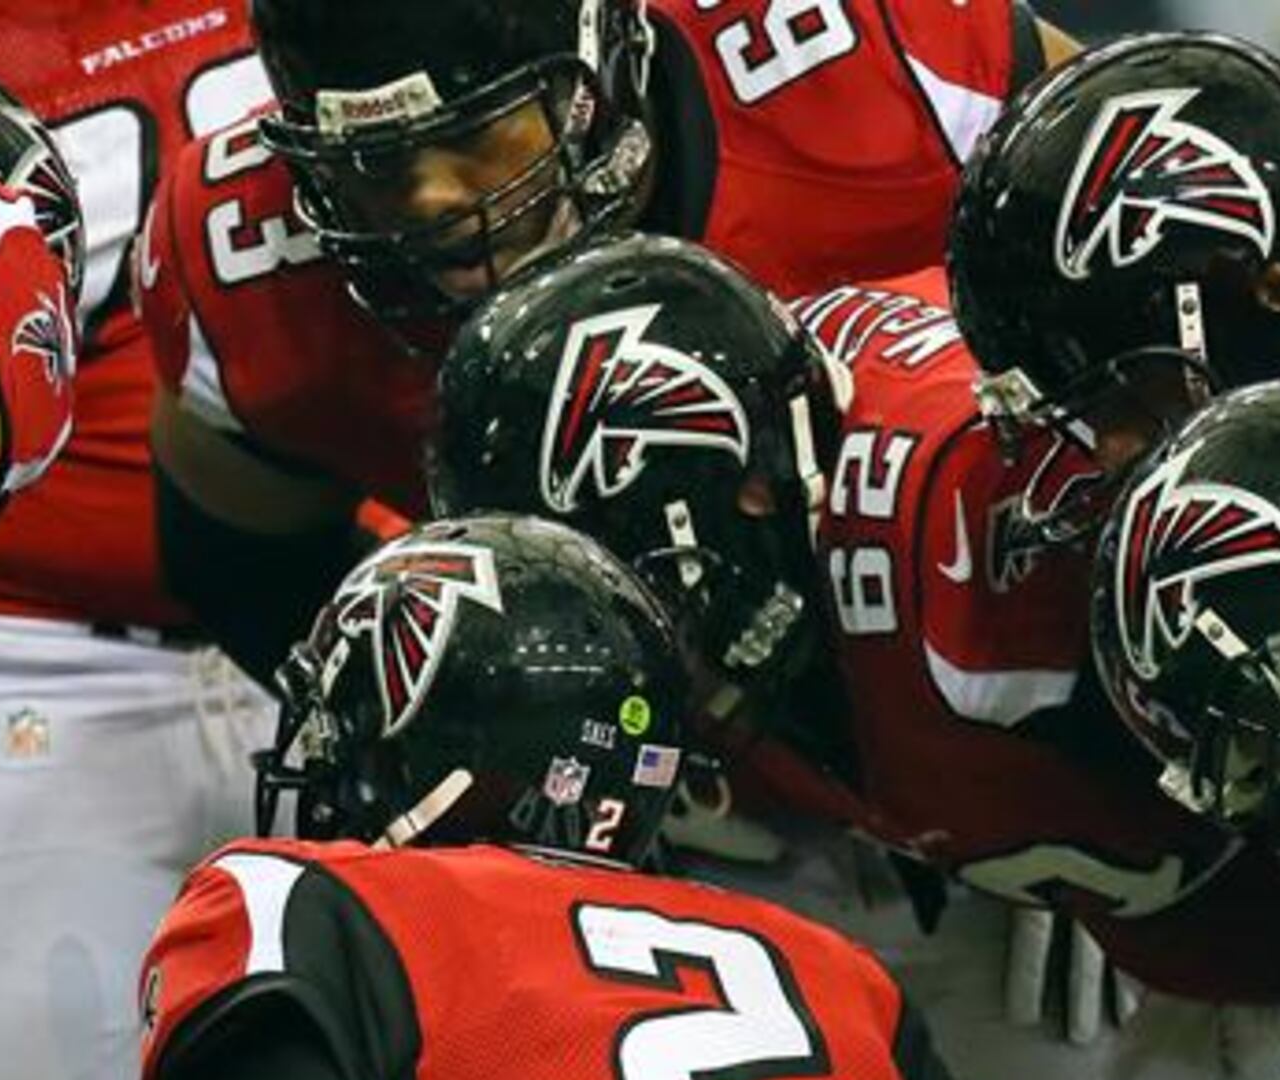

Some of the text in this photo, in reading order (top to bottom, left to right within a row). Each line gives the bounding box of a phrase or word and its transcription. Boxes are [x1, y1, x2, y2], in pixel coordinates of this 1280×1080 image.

[81, 9, 227, 75] FALCONS
[697, 0, 857, 103] 6
[585, 798, 626, 851] 2
